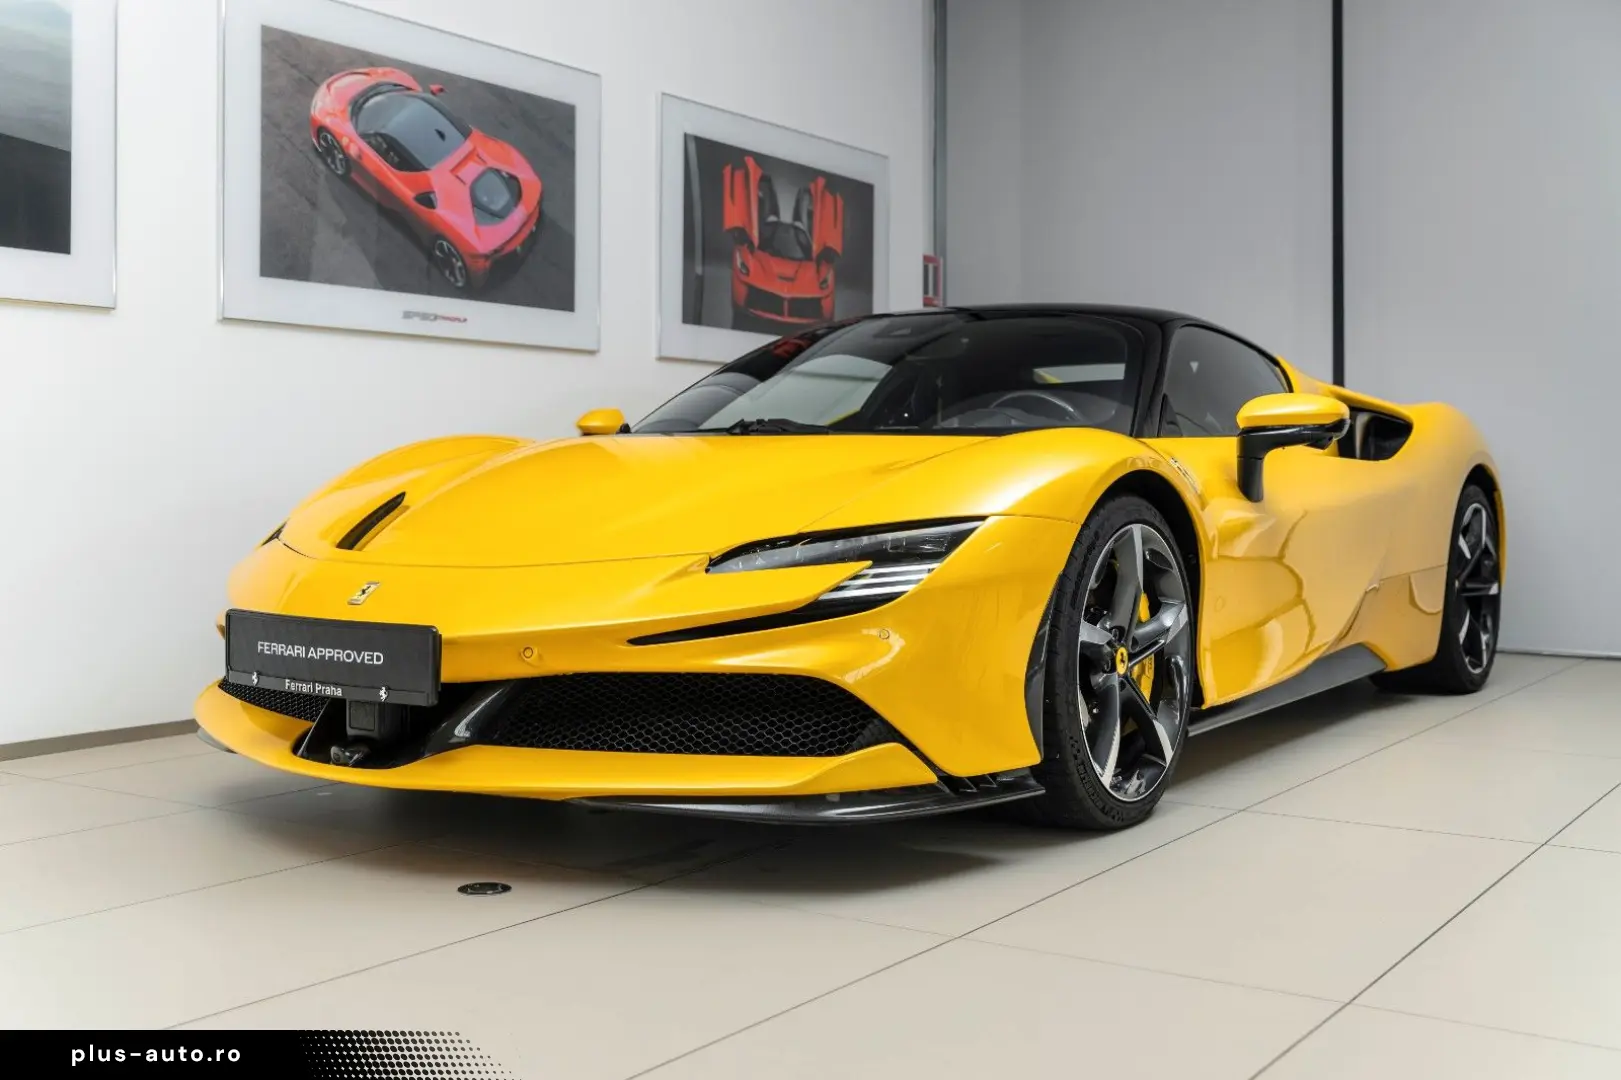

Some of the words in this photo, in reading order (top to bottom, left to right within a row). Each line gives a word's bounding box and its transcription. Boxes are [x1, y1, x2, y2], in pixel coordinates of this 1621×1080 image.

[257, 641, 306, 658] FERRARI
[308, 647, 384, 665] APPROVED
[285, 679, 313, 693] Ferrari
[315, 683, 342, 697] Praha
